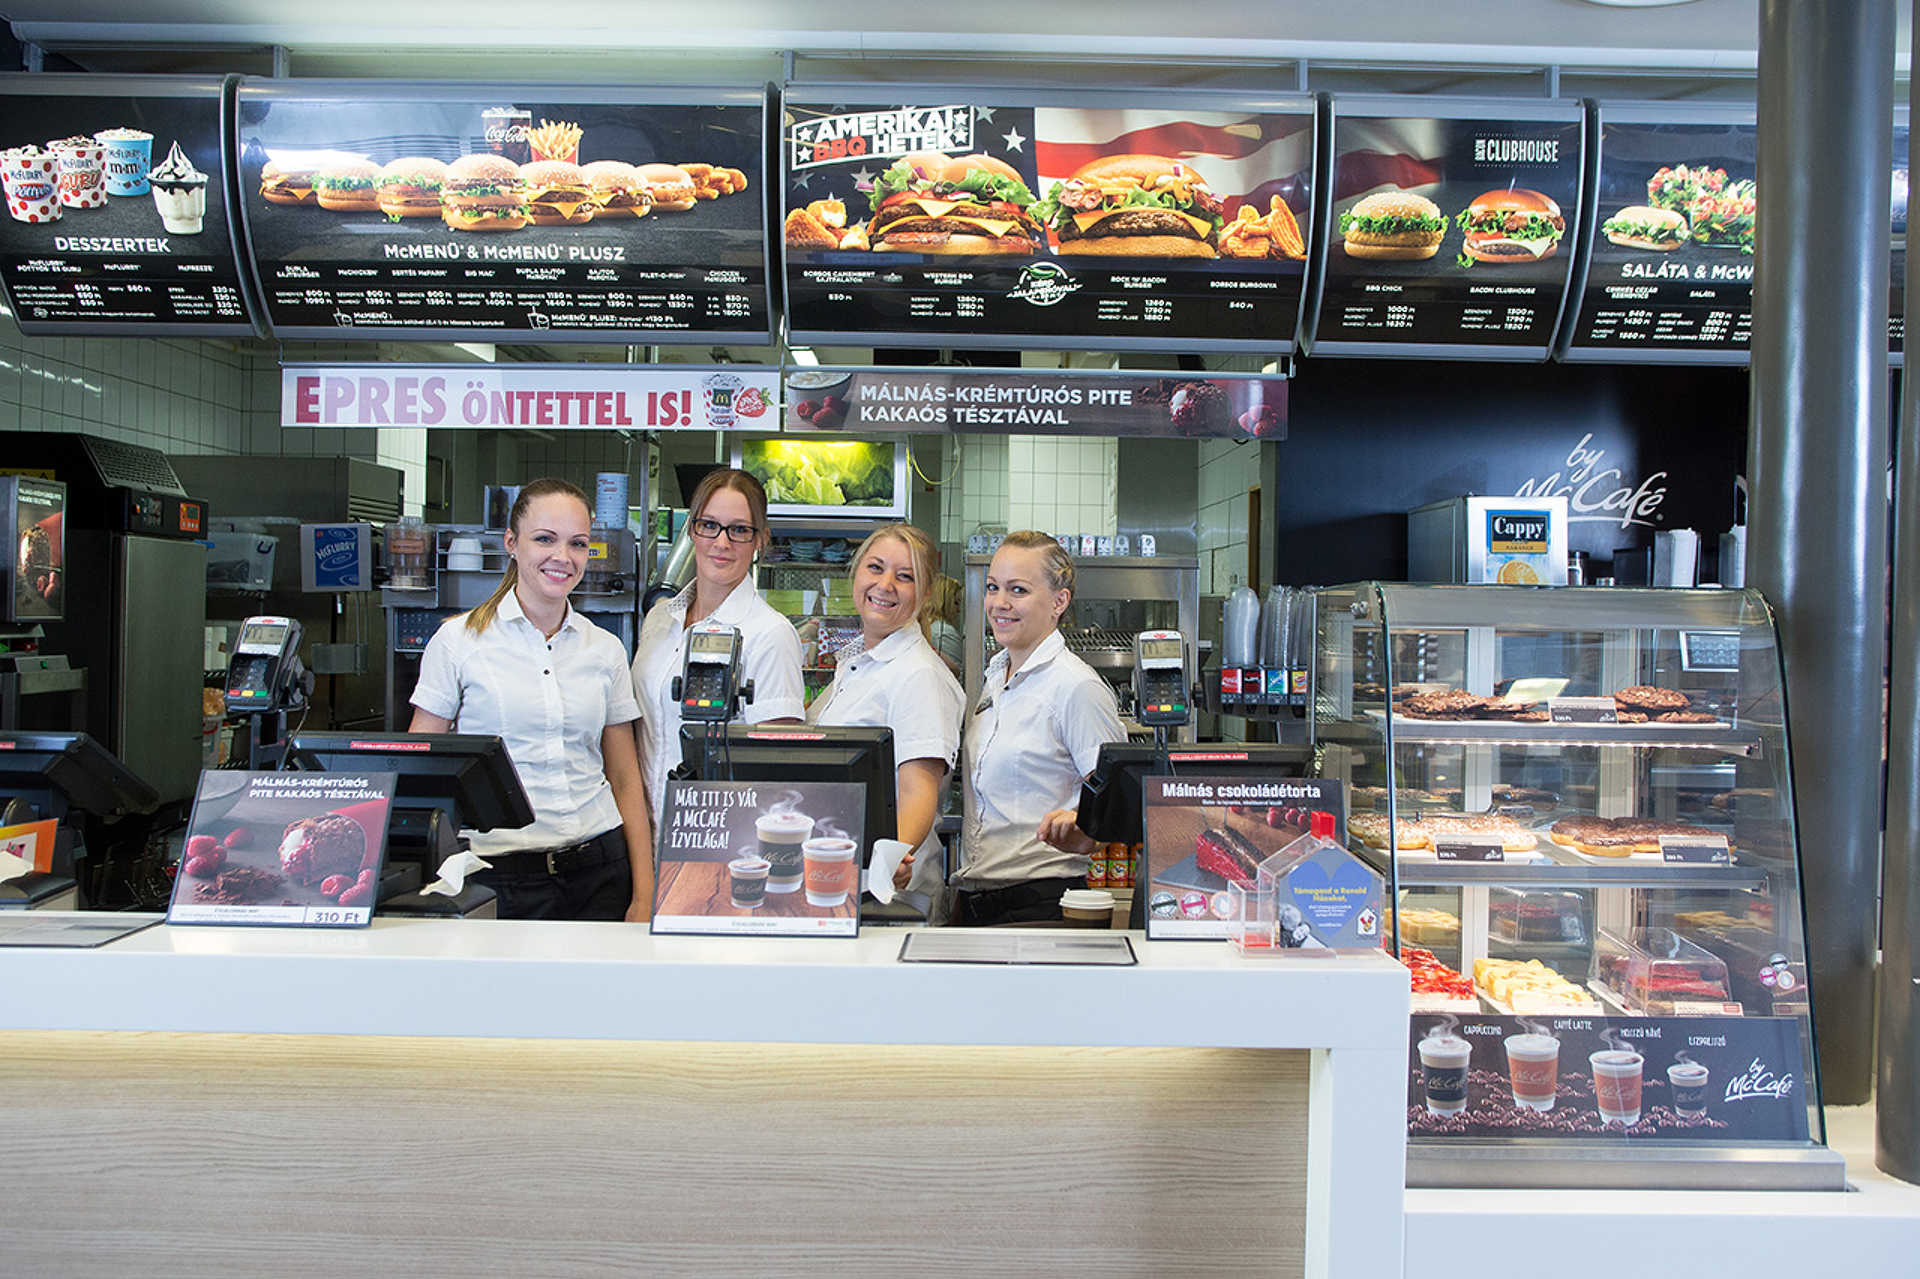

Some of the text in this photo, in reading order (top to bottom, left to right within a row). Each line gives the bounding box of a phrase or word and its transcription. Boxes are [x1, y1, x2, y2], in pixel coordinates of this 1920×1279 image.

[815, 108, 954, 139] AMERIKAI
[814, 129, 956, 162] BBQ HETEK
[1487, 140, 1559, 162] CLUBHOUSE
[54, 236, 172, 252] DESSZERTEK
[467, 245, 479, 259] &
[569, 246, 625, 261] PLUSZ
[1621, 260, 1690, 278] SALÁTA
[1694, 265, 1708, 279] &
[296, 376, 447, 424] EPRES
[462, 380, 632, 426] ÖNTETTEL
[647, 390, 692, 426] IS!
[860, 382, 1132, 406] MÁLNÁS-KRÉMTÚRÓS PITE
[860, 404, 1069, 426] KAKAÓS TÉSZTÁVAL
[1566, 432, 1604, 483] by
[1494, 516, 1545, 540] Cappy
[252, 776, 369, 789] MÁLNÁS-KRÉMTÚRÓS
[1162, 782, 1321, 799] Málnás csokoládétorta
[250, 788, 385, 800] PITE KAKAÓS TÉSZTÁVAL
[674, 786, 758, 808] MÁR ITT IS VÁR
[672, 811, 680, 828] A
[670, 830, 730, 849] ÍZVILÁGA!
[314, 912, 361, 923] 310 Ft
[1748, 1057, 1766, 1080] by
[1725, 1073, 1793, 1099] McCafé
